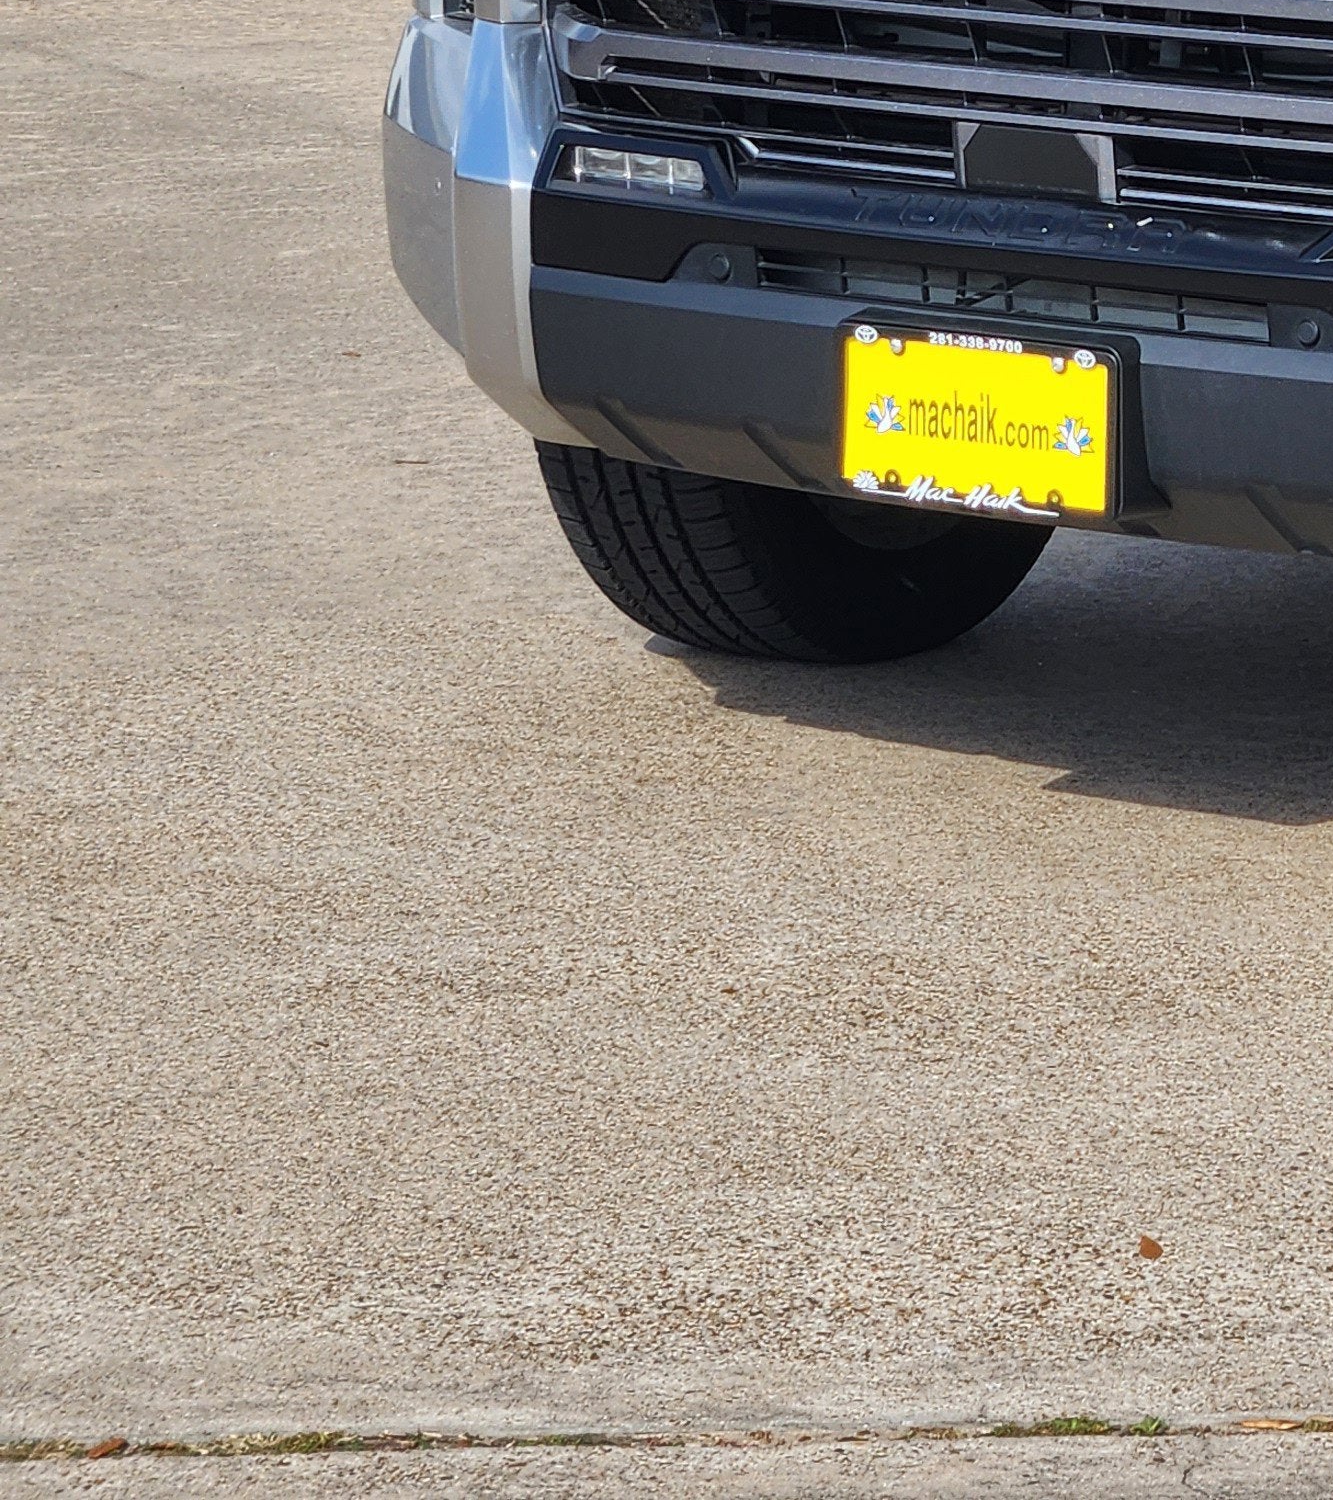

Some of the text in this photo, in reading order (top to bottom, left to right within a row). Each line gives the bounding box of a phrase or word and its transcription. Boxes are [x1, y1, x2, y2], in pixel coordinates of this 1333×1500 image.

[928, 331, 1023, 354] 281-338-9700
[908, 390, 1049, 451] machaik.com
[904, 474, 963, 503] Mac
